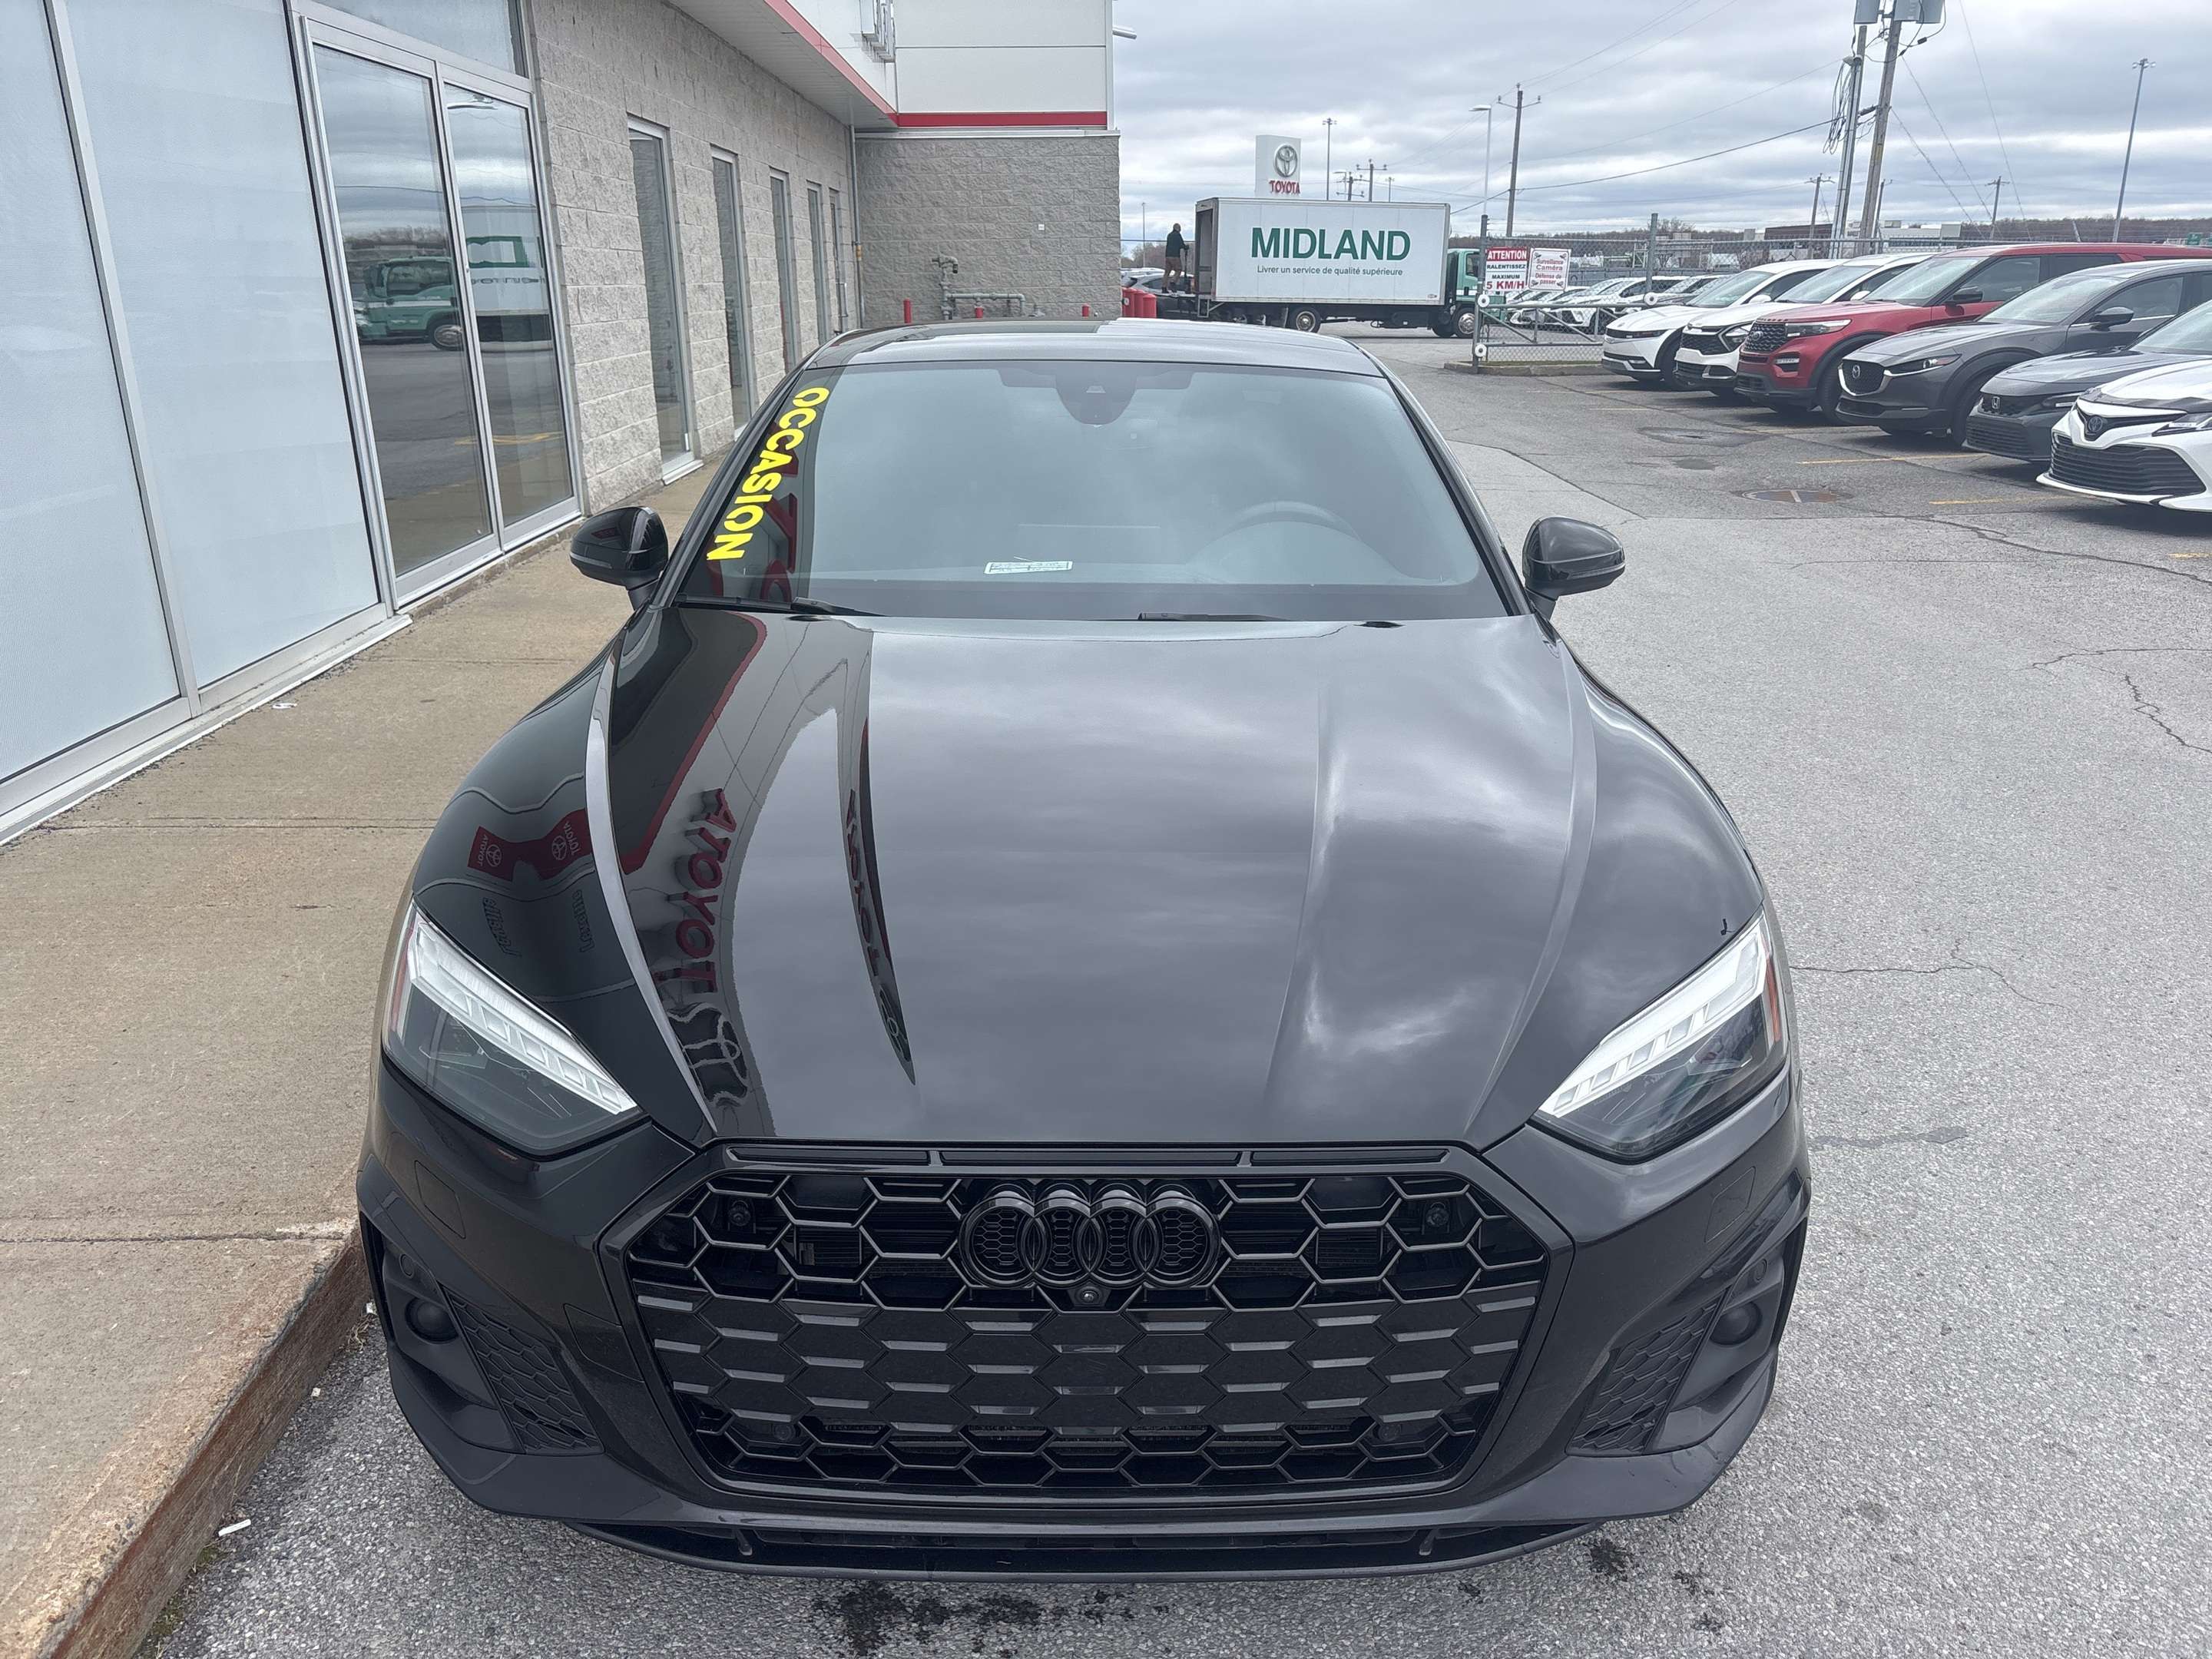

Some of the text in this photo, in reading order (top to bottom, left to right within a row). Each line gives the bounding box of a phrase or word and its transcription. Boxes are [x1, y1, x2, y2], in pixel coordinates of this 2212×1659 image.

[1269, 180, 1300, 194] TOYOTA
[1251, 227, 1411, 261] MIDLAND
[1487, 250, 1527, 260] ATTENTION
[1257, 265, 1280, 273] Livrer
[1293, 266, 1320, 274] service
[1334, 267, 1361, 276] qualité
[1363, 267, 1403, 276] supérieure
[1496, 281, 1525, 290] KM/H
[707, 387, 830, 560] OCCASION
